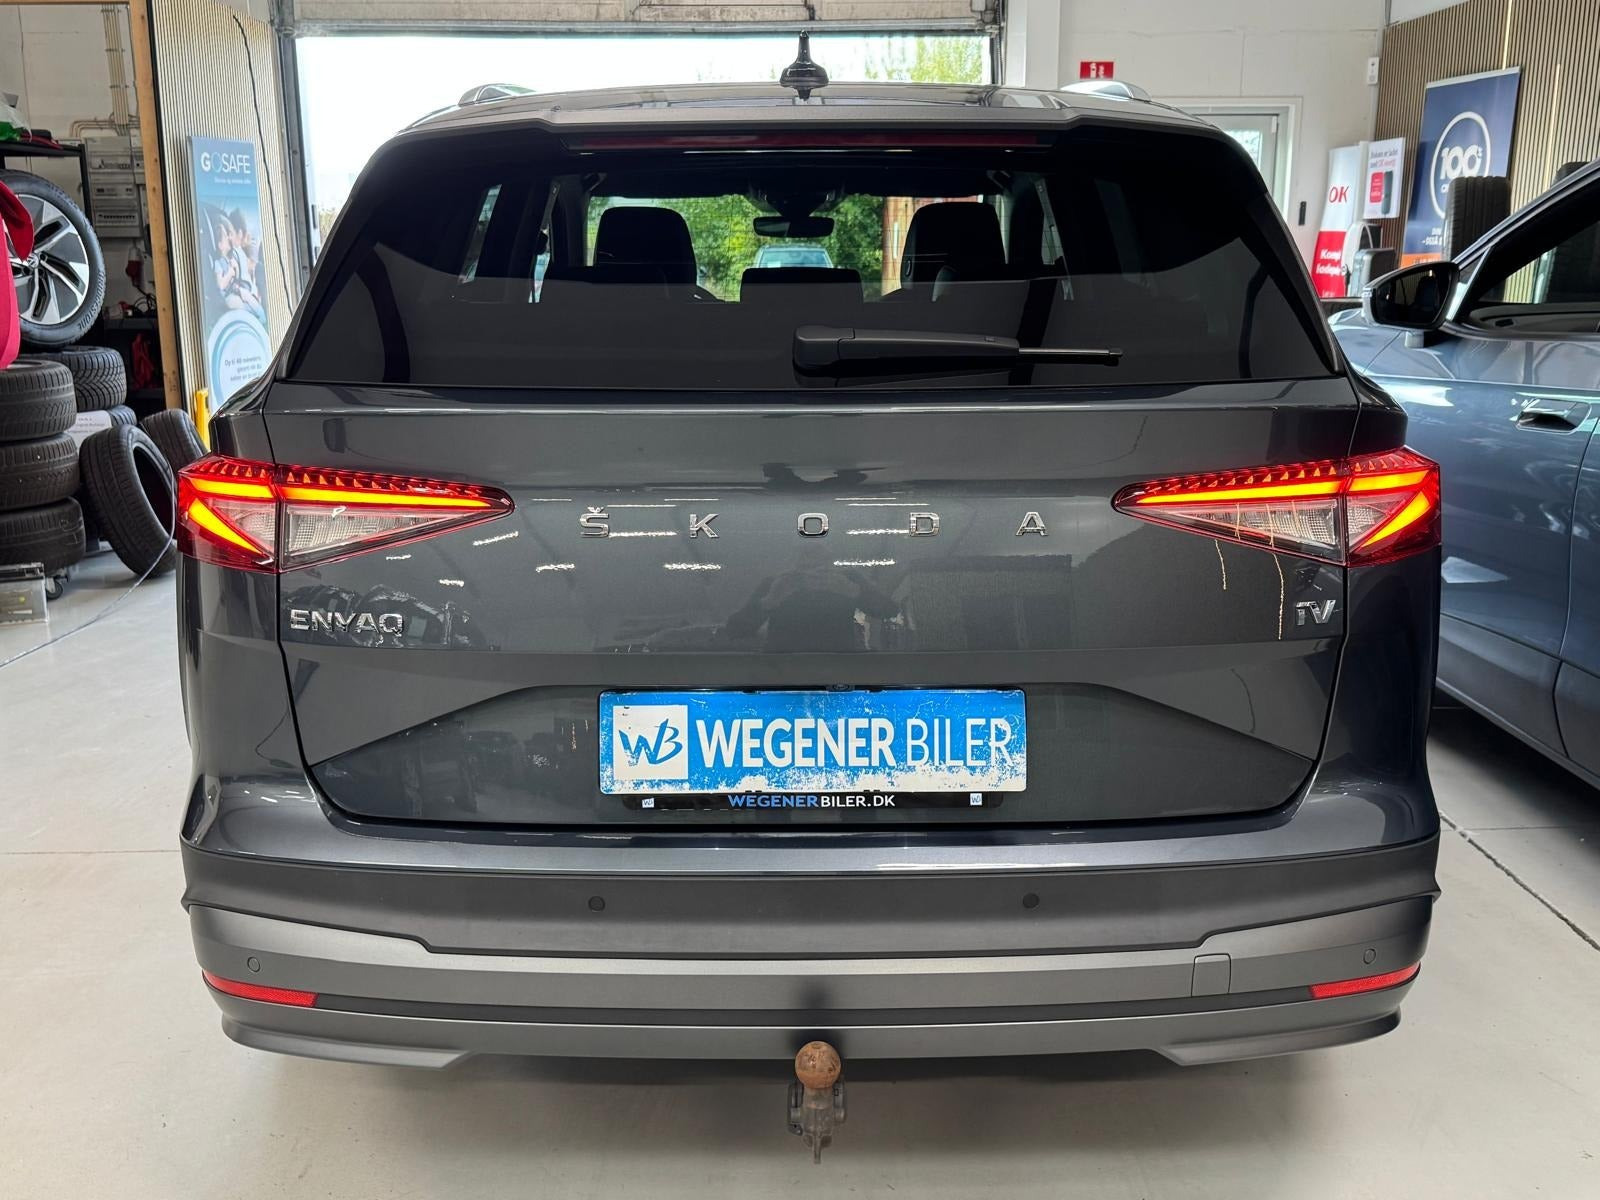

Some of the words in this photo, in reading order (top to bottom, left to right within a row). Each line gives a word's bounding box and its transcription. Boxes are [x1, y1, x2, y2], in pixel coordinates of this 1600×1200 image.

[201, 152, 251, 174] GOSAFE
[1329, 186, 1349, 203] OK
[579, 505, 1048, 538] ŠKODA
[289, 609, 404, 637] ENYAQ
[696, 718, 895, 768] WEGENER
[906, 718, 1014, 767] BILER
[727, 794, 896, 808] WEGENERBILER.DK
